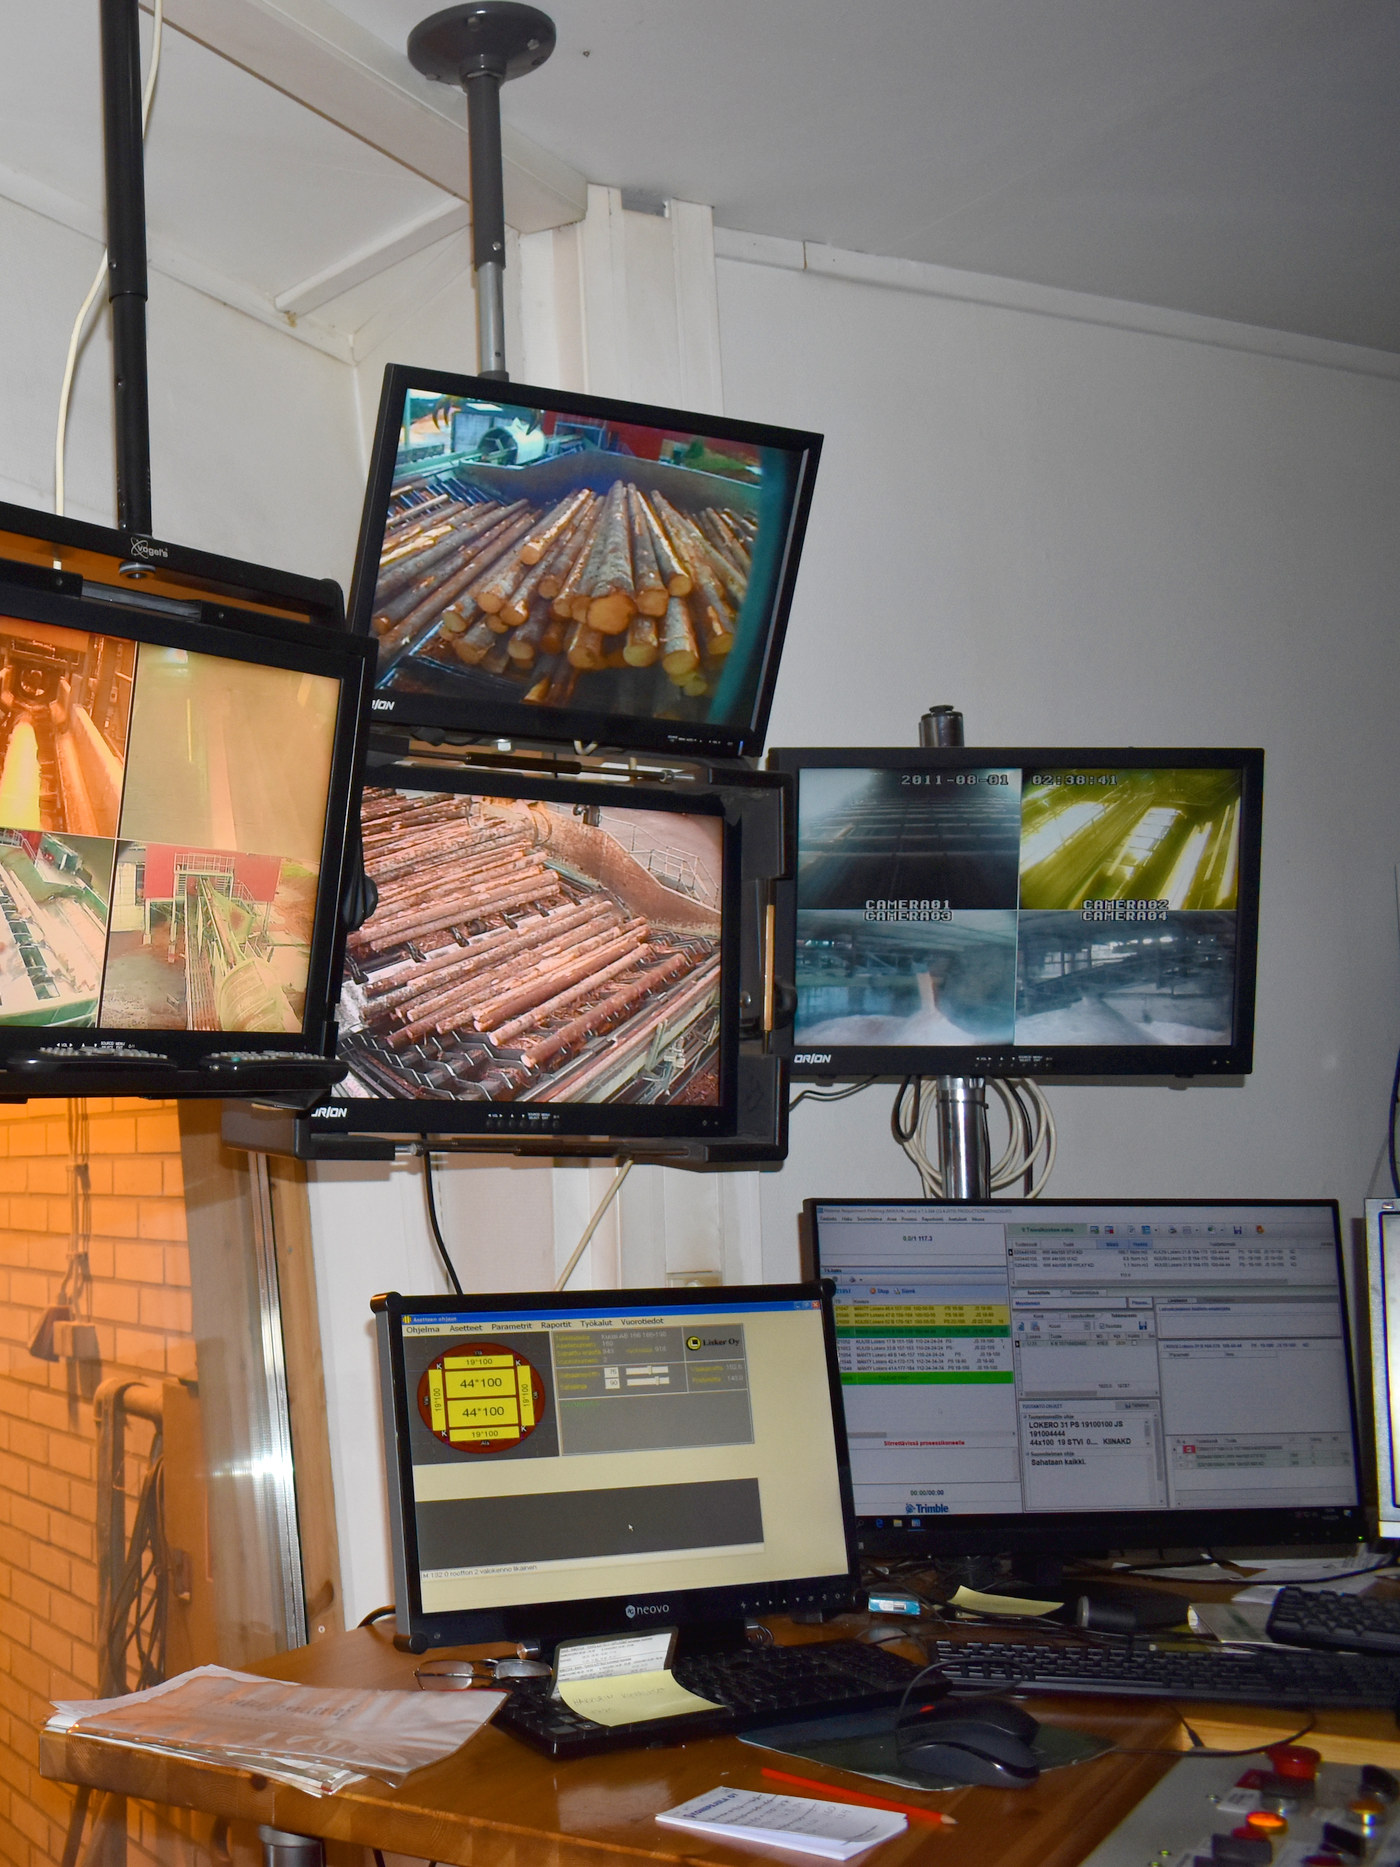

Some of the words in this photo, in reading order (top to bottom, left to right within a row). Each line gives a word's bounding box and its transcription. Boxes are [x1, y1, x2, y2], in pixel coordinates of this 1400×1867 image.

[137, 544, 168, 558] vogel's
[901, 774, 1009, 786] 2011-08-01
[1032, 774, 1118, 786] 02:38:41
[865, 899, 951, 910] CAMERA01
[1083, 899, 1170, 910] CAMERA02
[864, 910, 953, 922] CAMERA03
[1081, 910, 1168, 922] CAMERA04
[794, 1054, 831, 1064] ORION
[406, 1326, 440, 1334] Ohjelma
[449, 1324, 483, 1332] Asetteet
[492, 1322, 532, 1331] Parametrit
[541, 1321, 572, 1330] Raportit
[580, 1319, 612, 1329] Työkalut
[620, 1317, 664, 1326] Vuorotiedot
[728, 1337, 740, 1346] Oy
[1029, 1421, 1059, 1429] LOKERO
[1114, 1420, 1124, 1428] JS
[1030, 1438, 1054, 1446] 44x100
[916, 1503, 949, 1513] Trimble
[637, 1604, 670, 1615] neovo
